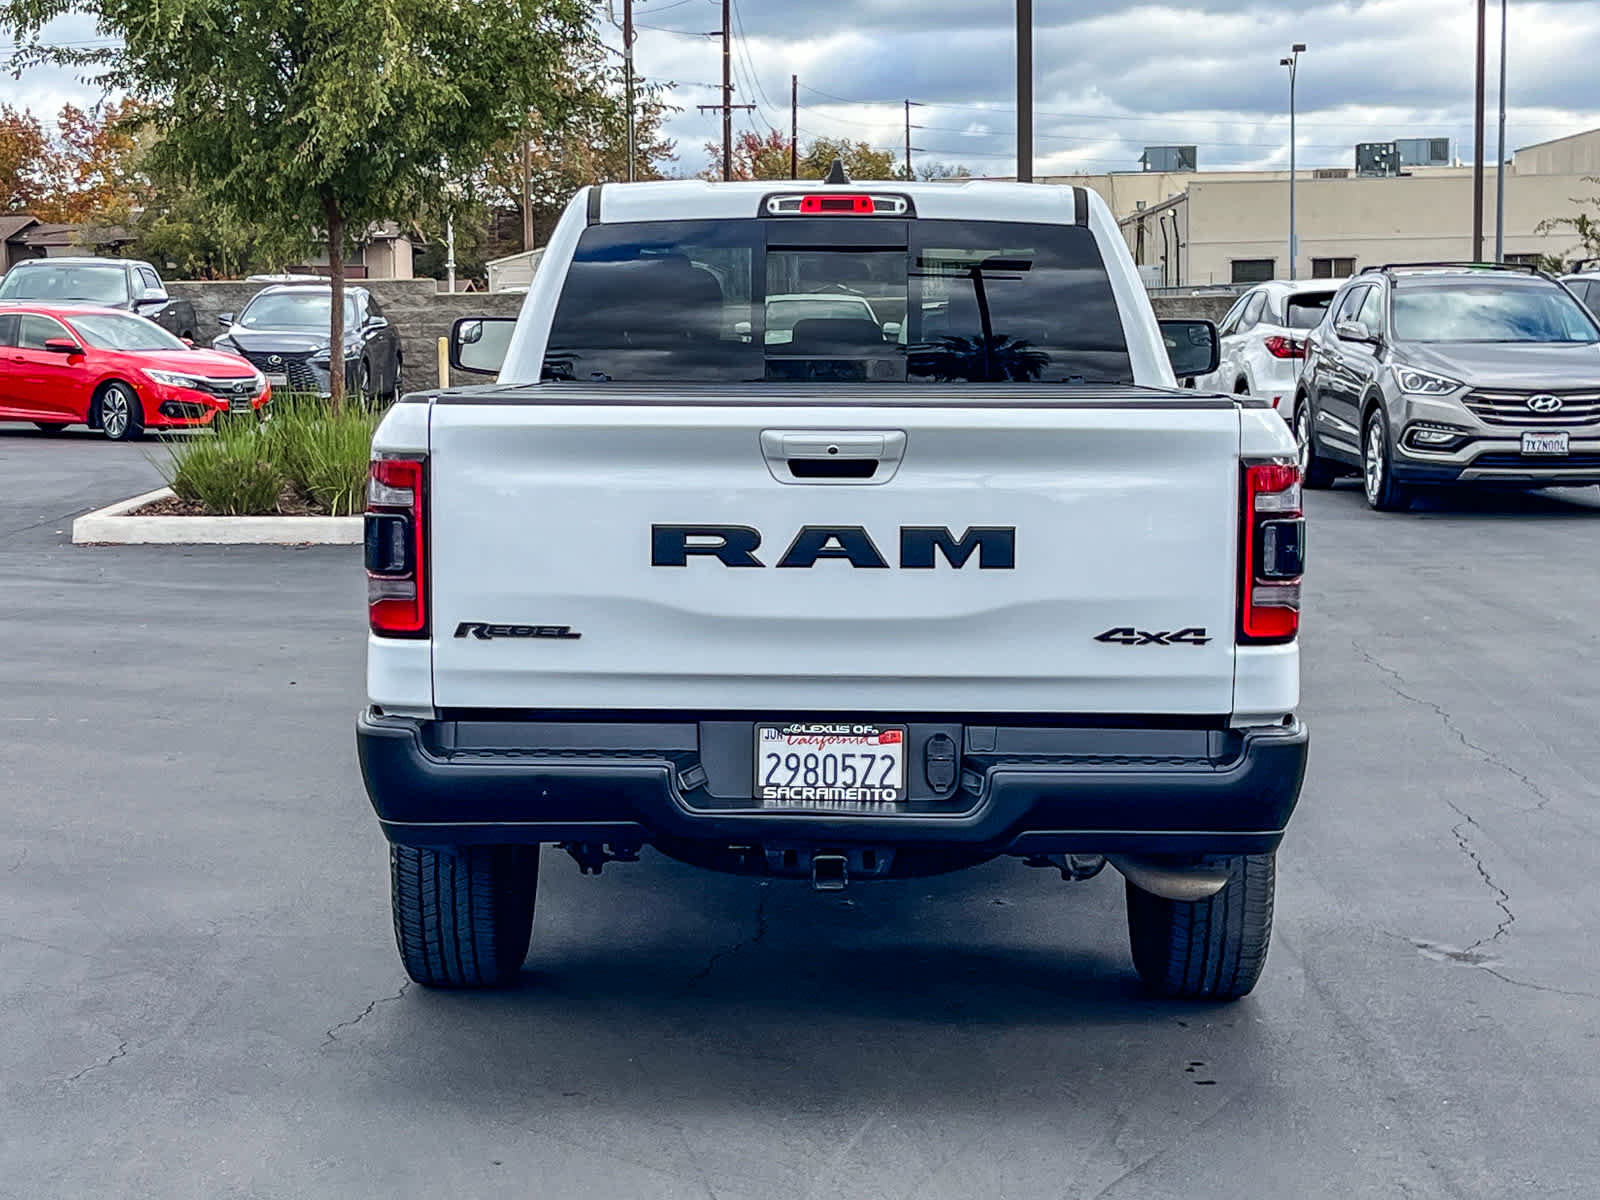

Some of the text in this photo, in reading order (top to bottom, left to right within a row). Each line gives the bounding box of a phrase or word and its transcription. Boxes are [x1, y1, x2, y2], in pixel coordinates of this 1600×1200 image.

[651, 523, 1016, 569] RAM
[801, 724, 874, 734] LEXUS OF
[763, 786, 897, 801] SACRAMENTO
